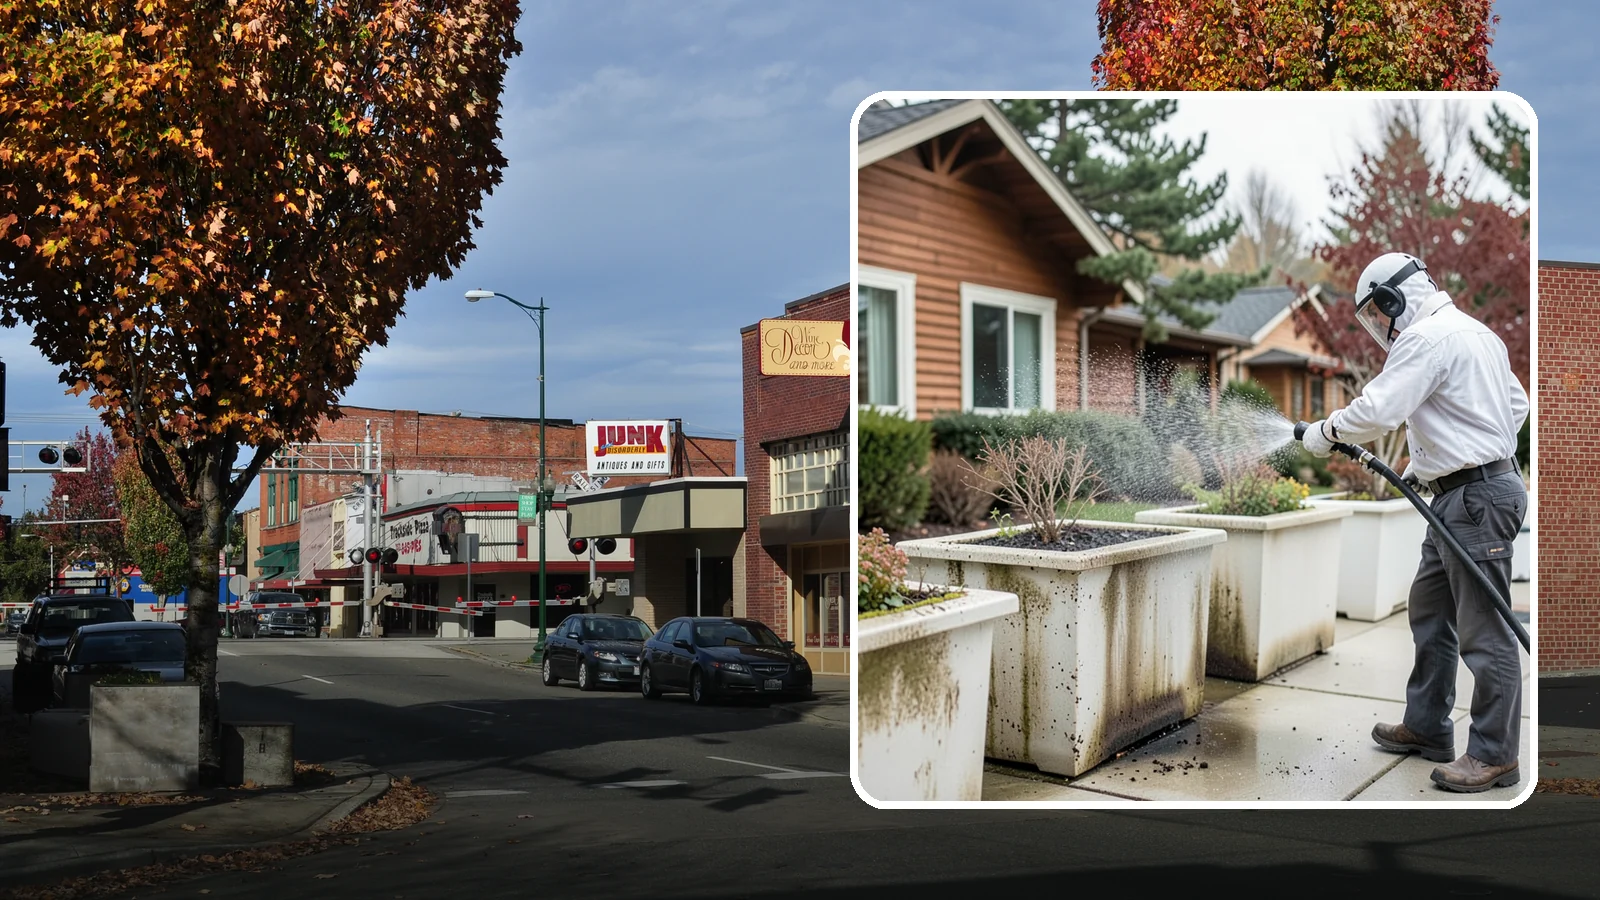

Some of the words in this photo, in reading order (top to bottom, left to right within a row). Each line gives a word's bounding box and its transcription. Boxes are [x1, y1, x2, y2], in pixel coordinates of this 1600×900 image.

[765, 327, 830, 365] Decor
[595, 425, 664, 457] JUNK
[597, 461, 628, 470] ANTIQUES
[631, 461, 644, 469] AND
[647, 461, 665, 469] GIFTS
[390, 520, 412, 539] Trackside
[414, 519, 429, 534] Pizza
